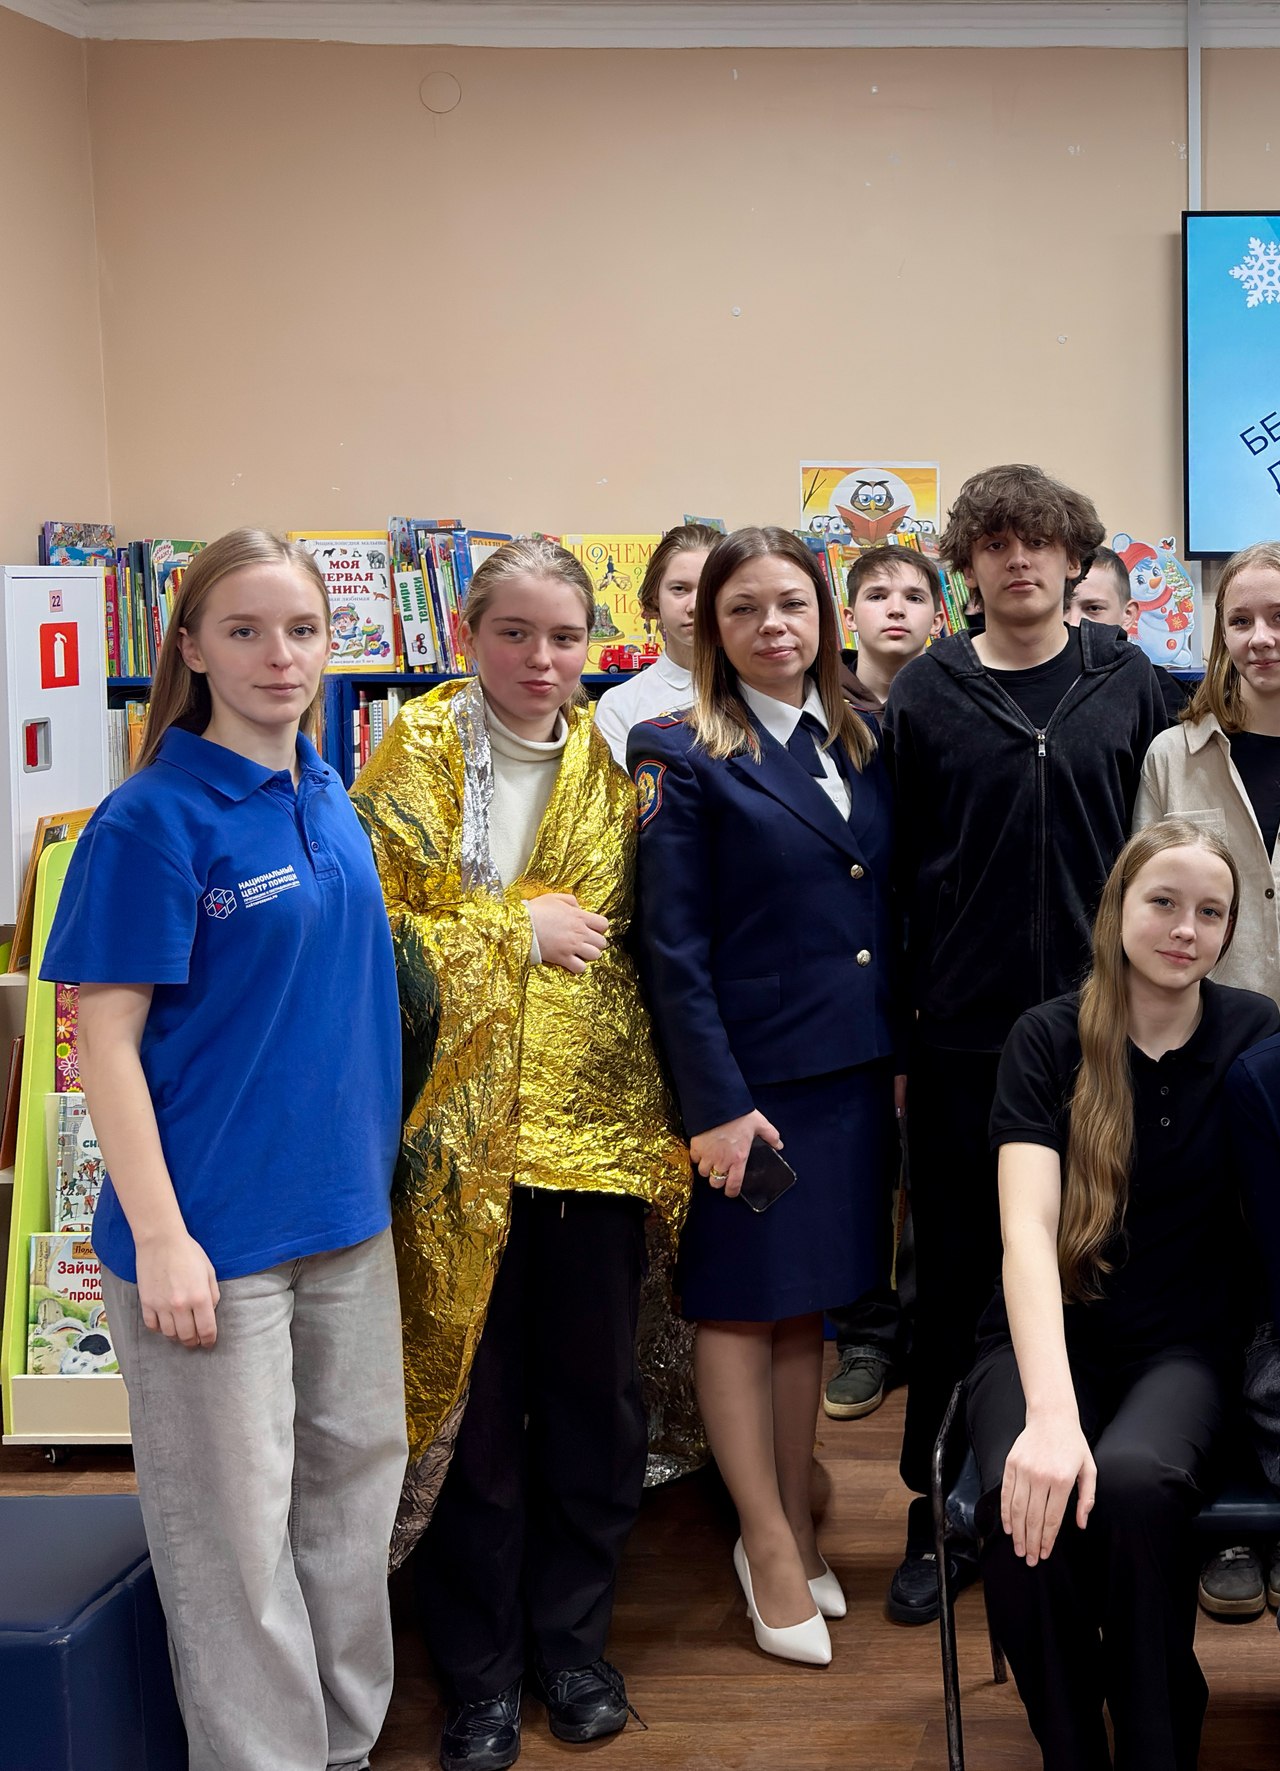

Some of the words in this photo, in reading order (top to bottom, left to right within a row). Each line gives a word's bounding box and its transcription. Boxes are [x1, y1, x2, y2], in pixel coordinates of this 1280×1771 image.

[329, 560, 360, 569] МОЯ
[52, 595, 61, 607] 22
[399, 581, 414, 612] мире
[412, 576, 429, 624] техники
[403, 614, 413, 622] В
[238, 864, 295, 890] НАЦИОНАЛЬНЫЙ
[240, 883, 268, 898] ЦЕНТР
[267, 873, 298, 888] ПОМОЩИ
[82, 1140, 99, 1148] СН
[57, 1260, 102, 1274] Зайчи
[69, 1291, 104, 1303] прош
